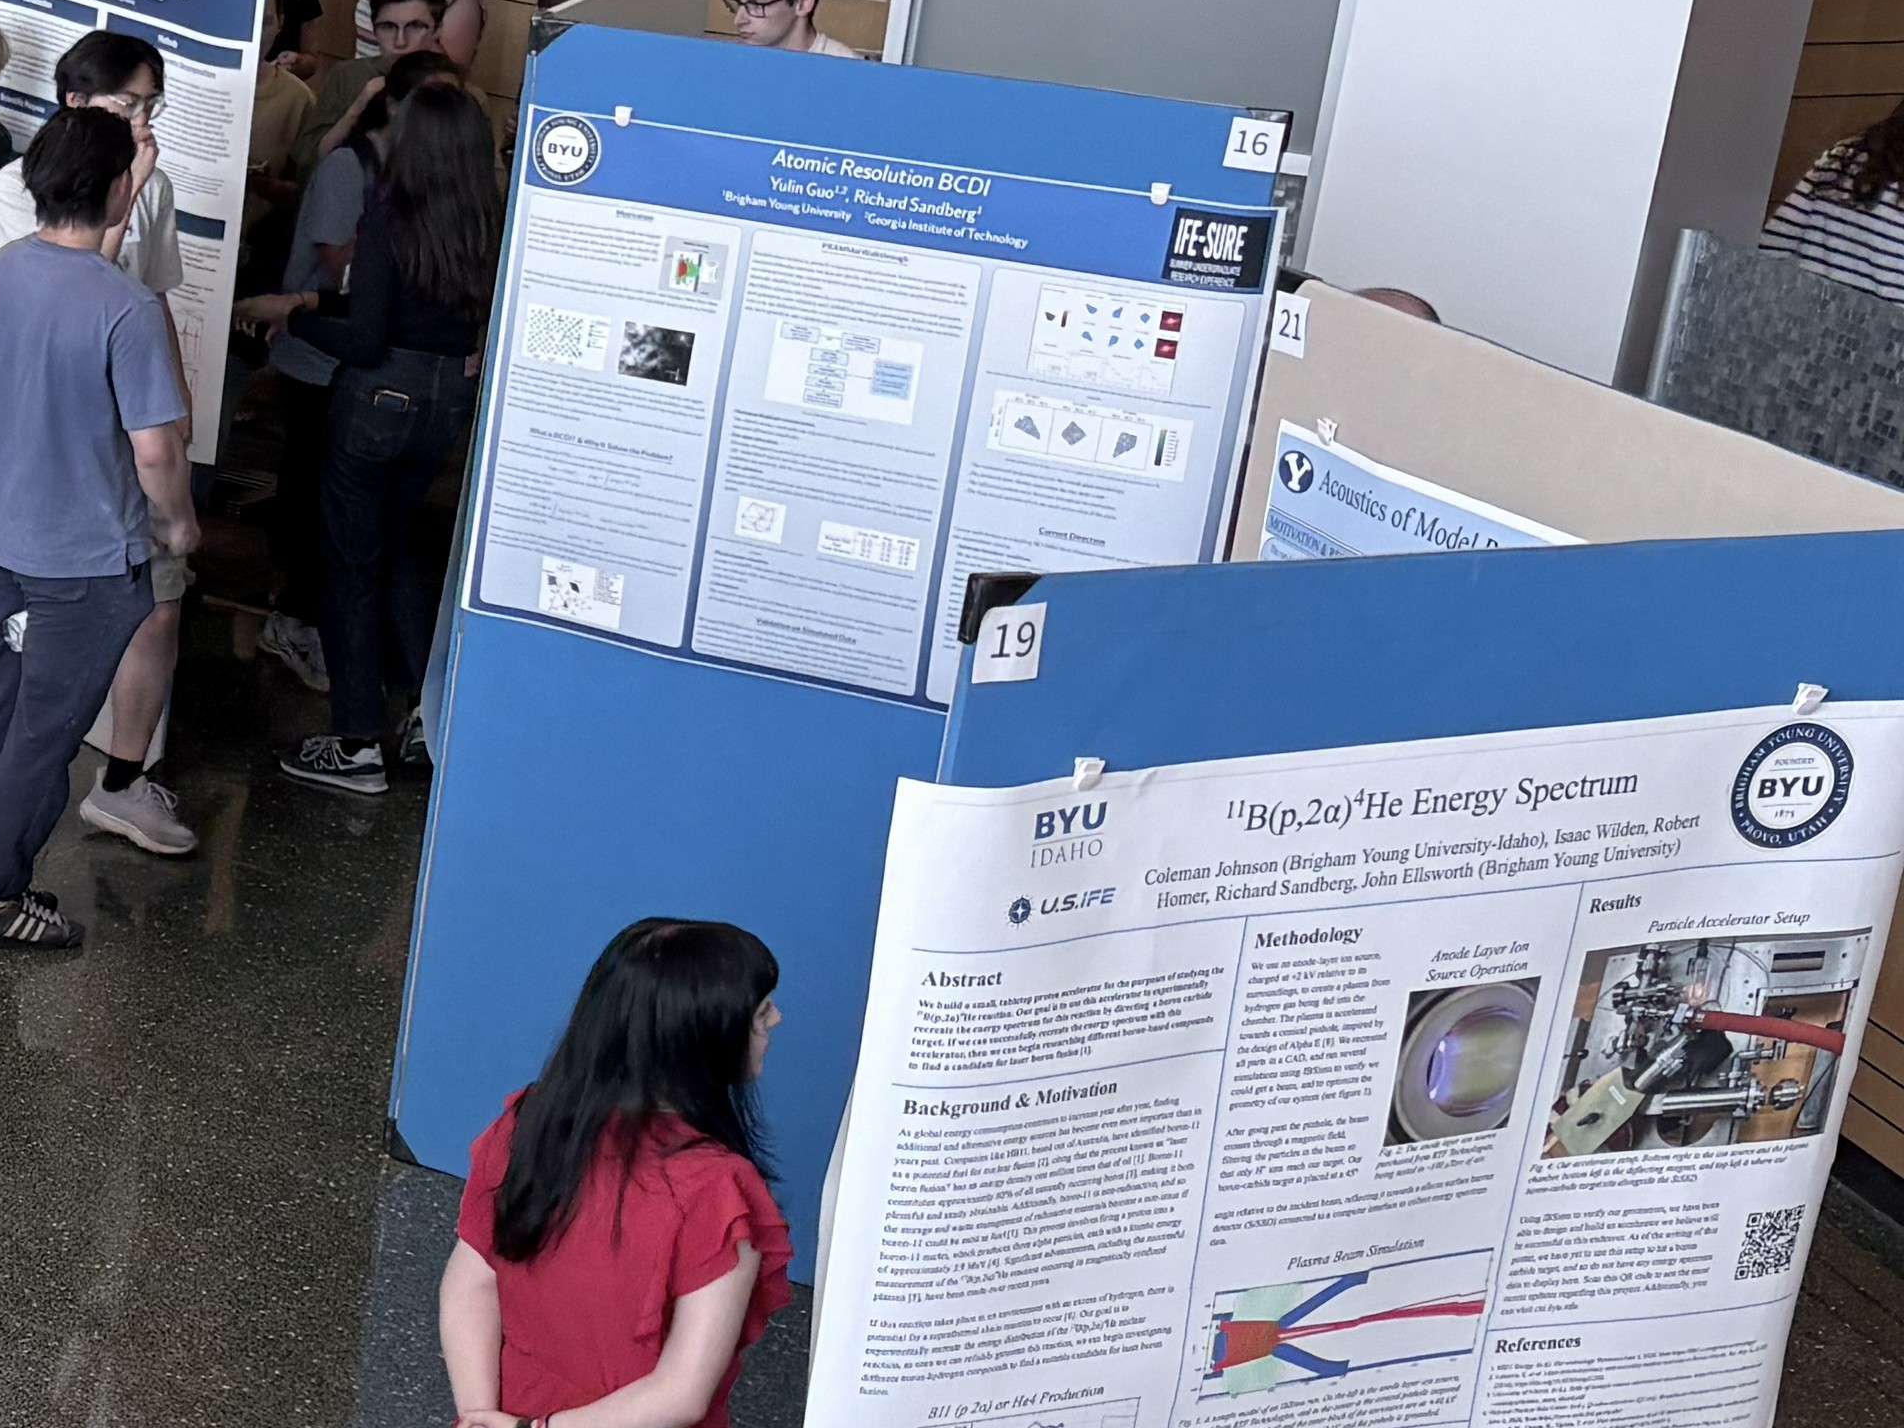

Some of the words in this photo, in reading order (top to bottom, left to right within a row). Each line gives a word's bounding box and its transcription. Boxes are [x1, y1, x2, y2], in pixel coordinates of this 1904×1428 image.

[548, 142, 583, 158] BYU
[1233, 130, 1270, 156] 16
[772, 148, 837, 175] Atomic
[840, 158, 934, 188] Resolution
[938, 172, 991, 197] BCDI
[770, 176, 804, 195] Yulin
[854, 188, 908, 211] Richard
[768, 198, 800, 215] Young
[802, 203, 852, 223] University
[908, 219, 953, 236] Institute
[953, 227, 967, 238] of
[968, 228, 1028, 250] Technology
[1173, 217, 1249, 262] IFE-SURE
[1279, 308, 1302, 341] 21
[1284, 452, 1312, 492] Y
[1318, 469, 1388, 522] Acoustics
[1391, 507, 1417, 528] of
[990, 621, 1035, 659] 19
[1413, 787, 1508, 817] Energy
[1515, 774, 1639, 811] Spectrum
[1757, 775, 1825, 799] BYU
[1033, 801, 1108, 840] BYU
[1030, 838, 1103, 868] IDAHO
[1144, 866, 1211, 886] Coleman
[1215, 859, 1278, 878] Johnson
[1554, 828, 1591, 845] Isaac
[1653, 814, 1700, 833] Robert
[1361, 871, 1397, 888] John
[1402, 861, 1473, 884] Ellsworth
[1589, 894, 1641, 914] Results
[1254, 926, 1363, 949] Methodology
[1648, 916, 1694, 933] Particle
[1774, 911, 1811, 927] Setup
[921, 970, 1002, 988] Abstract
[903, 1090, 1010, 1119] Background
[1035, 1080, 1118, 1106] Motivation
[1495, 1337, 1581, 1354] References
